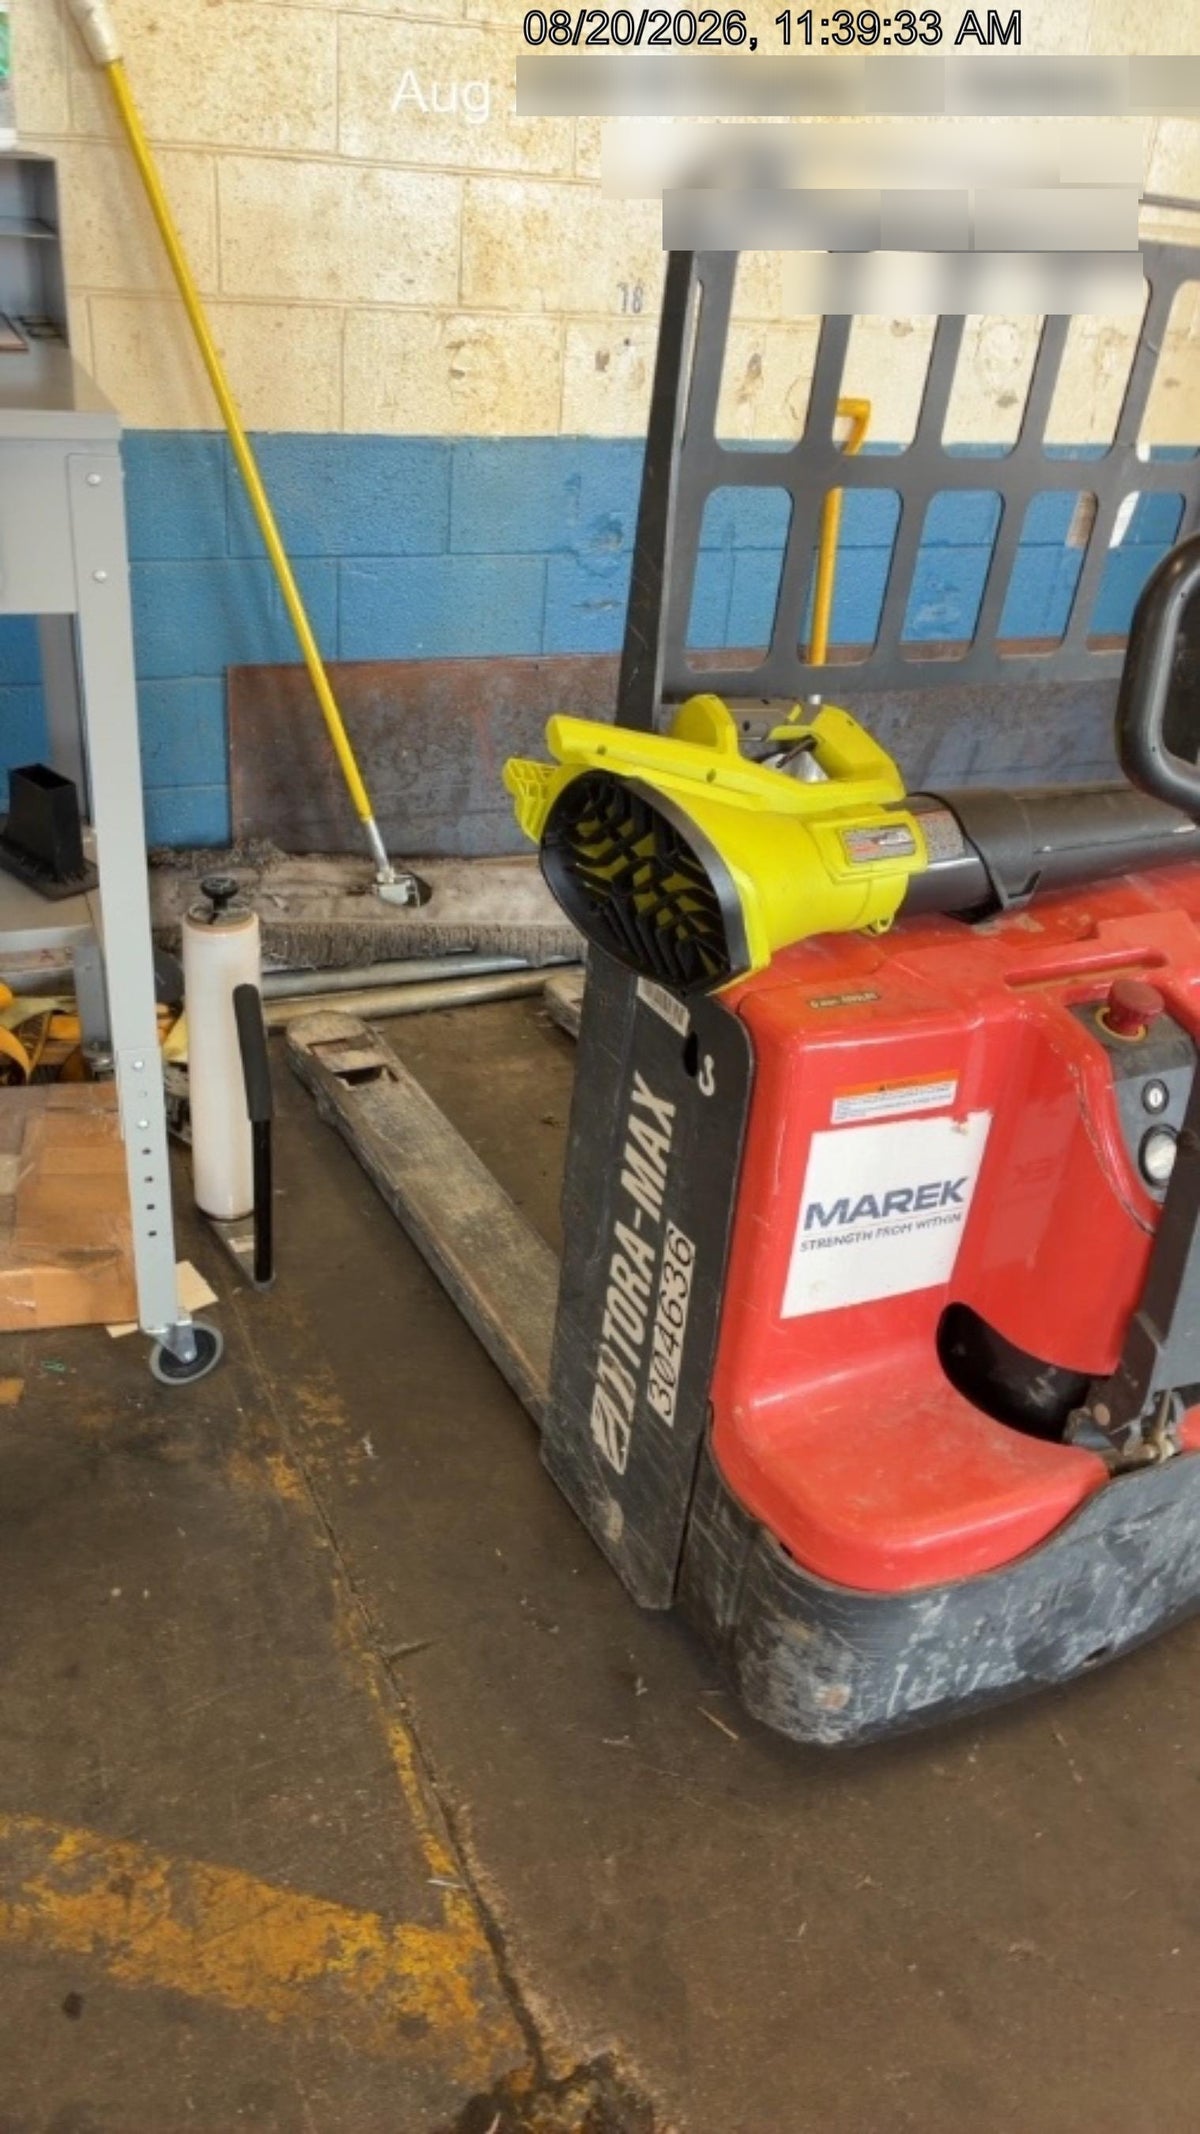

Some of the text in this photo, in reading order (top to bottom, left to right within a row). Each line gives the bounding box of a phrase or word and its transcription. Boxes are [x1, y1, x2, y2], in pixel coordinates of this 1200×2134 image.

[804, 1177, 968, 1230] MAREK
[801, 1213, 962, 1251] STRENGTH FROM WITHIN
[648, 1222, 693, 1419] 304636
